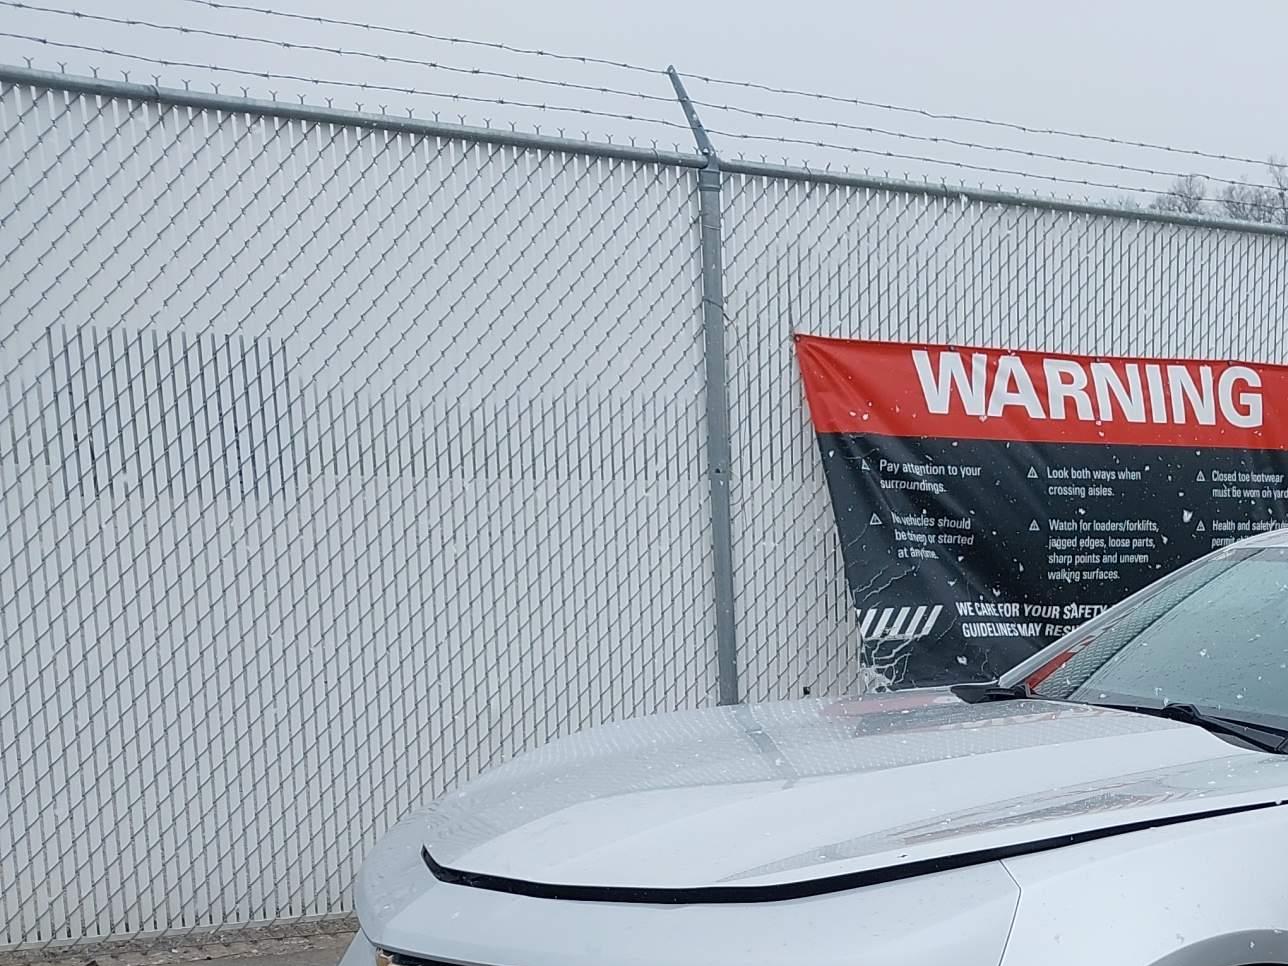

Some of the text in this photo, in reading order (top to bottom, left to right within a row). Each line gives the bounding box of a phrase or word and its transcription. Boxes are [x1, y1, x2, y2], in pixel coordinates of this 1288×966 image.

[911, 349, 1264, 429] WARNING
[880, 459, 981, 478] Pay attention to your
[1047, 466, 1141, 482] Look both ways when
[1211, 470, 1284, 483] Closed toe footwear
[880, 480, 947, 494] surroundings.
[1048, 484, 1115, 498] crossing aisles.
[1212, 487, 1231, 498] must
[1232, 486, 1242, 498] be
[1243, 489, 1260, 498] worn
[1261, 489, 1272, 498] on
[901, 514, 935, 527] vehicles
[937, 516, 971, 530] should
[1048, 519, 1160, 533] Watch for loaders/forklifts,
[1212, 519, 1236, 531] Health
[1237, 519, 1251, 531] and
[1251, 519, 1273, 532] safety
[894, 528, 907, 541] be
[927, 534, 936, 543] or
[937, 533, 974, 546] started
[1048, 536, 1155, 550] jagged edges, loose parts,
[1211, 535, 1235, 549] permit
[897, 547, 909, 558] at
[1048, 552, 1149, 566] sharp points and uneven
[1047, 568, 1120, 582] walking surfaces.
[956, 601, 1108, 619] WE CARE FOR YOUR SAFETY
[961, 623, 1018, 638] GUIDELINES
[1016, 623, 1041, 637] MAY
